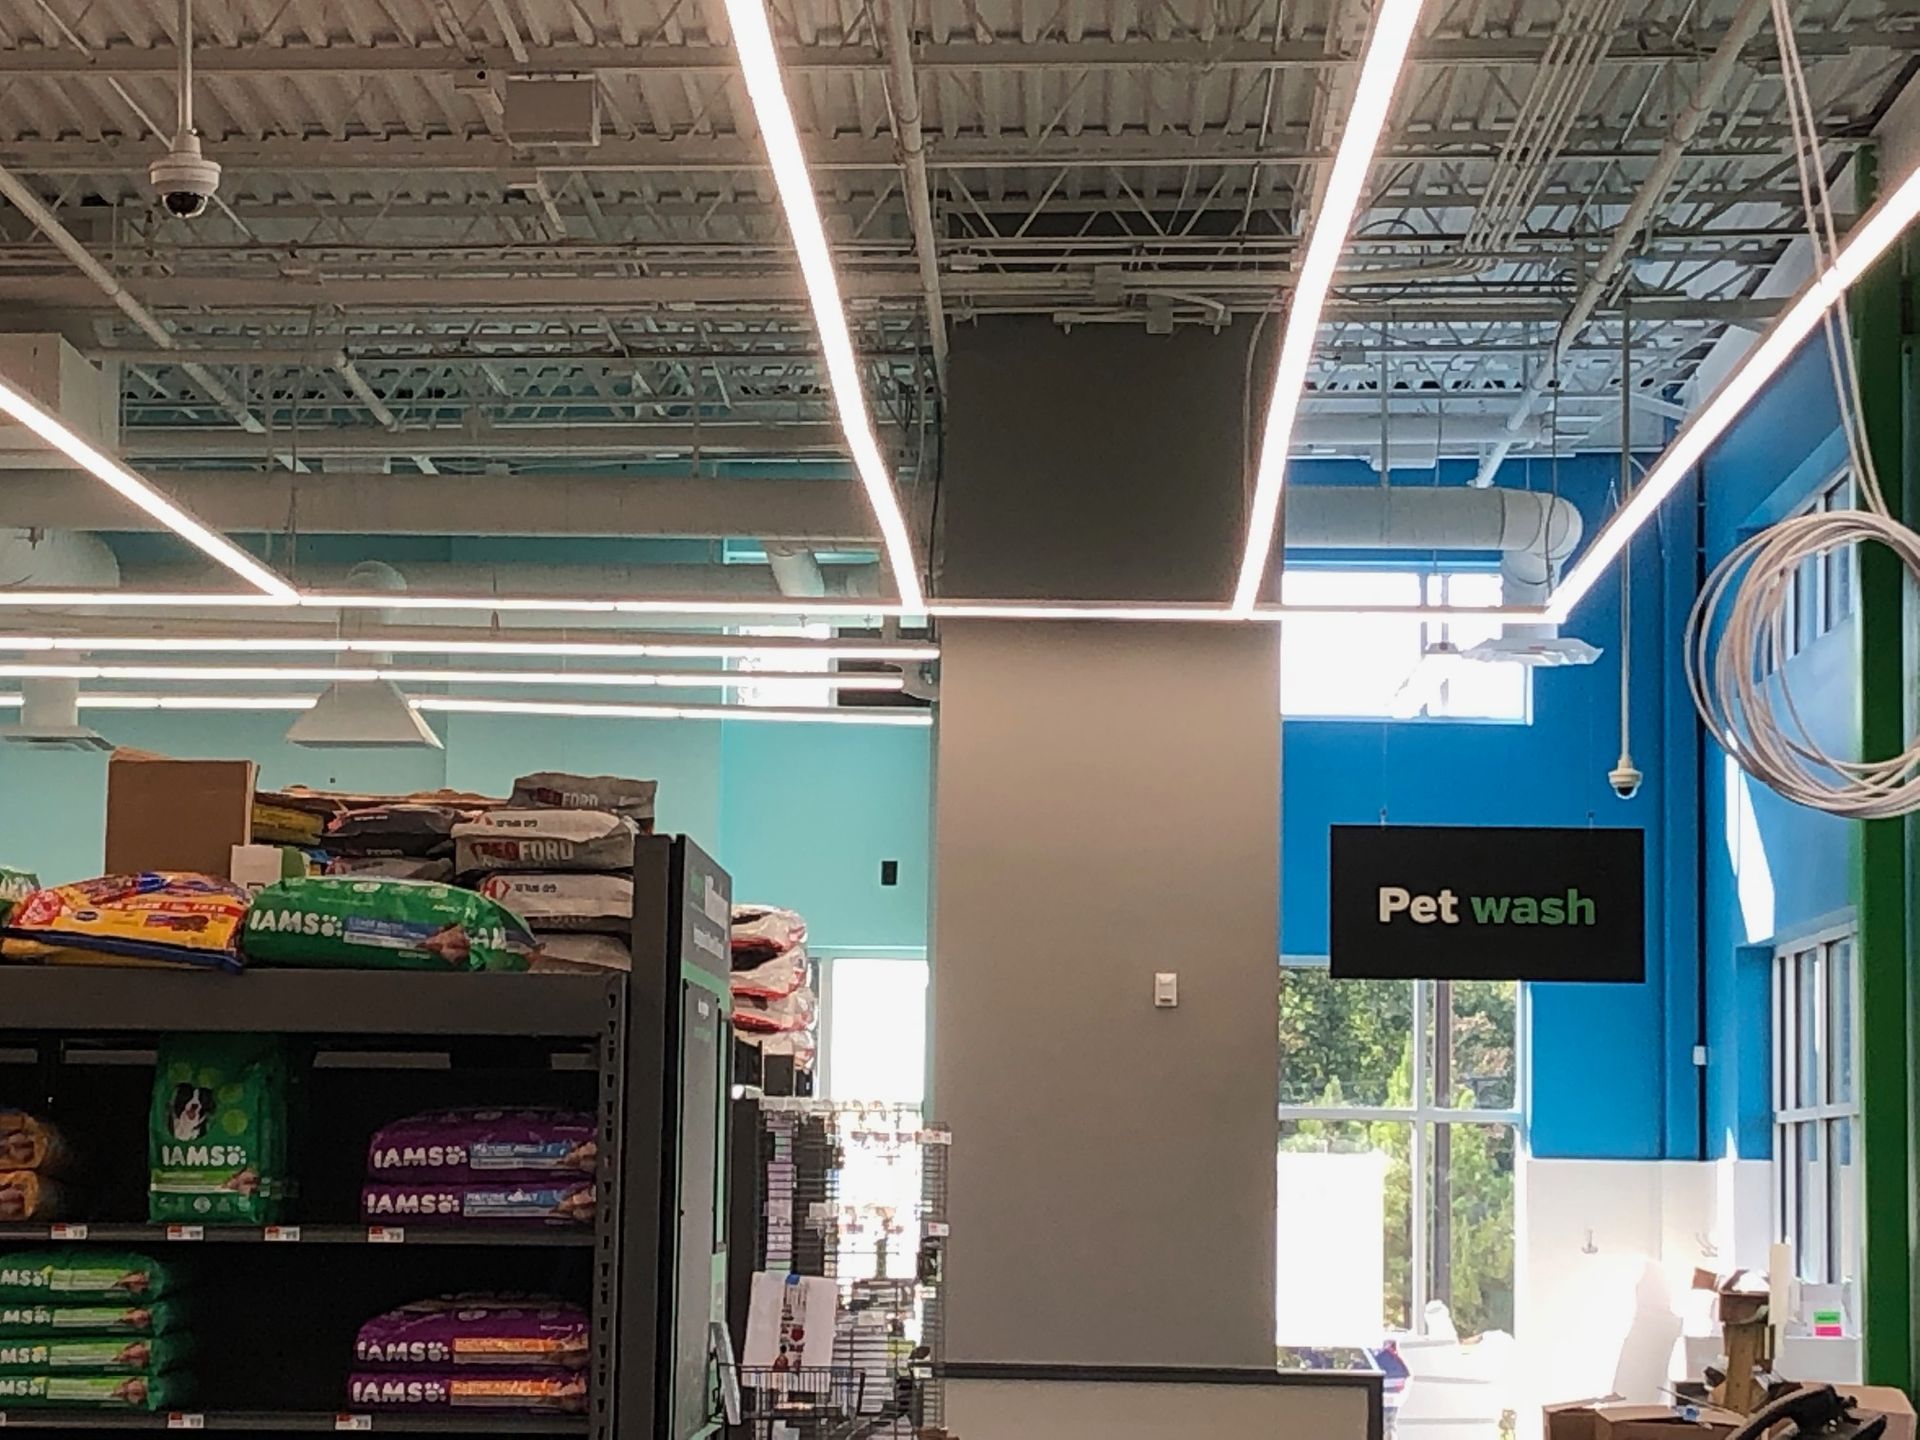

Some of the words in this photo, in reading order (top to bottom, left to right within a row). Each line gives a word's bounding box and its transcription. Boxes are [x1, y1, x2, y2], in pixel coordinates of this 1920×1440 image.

[1378, 887, 1460, 924] Pet
[1470, 888, 1596, 925] wash
[250, 909, 321, 936] IAMS
[162, 1145, 224, 1166] IAMS
[373, 1146, 444, 1168] IAMS
[367, 1193, 437, 1214] IAMS
[357, 1341, 425, 1362] IAMS
[353, 1382, 423, 1403] IAMS
